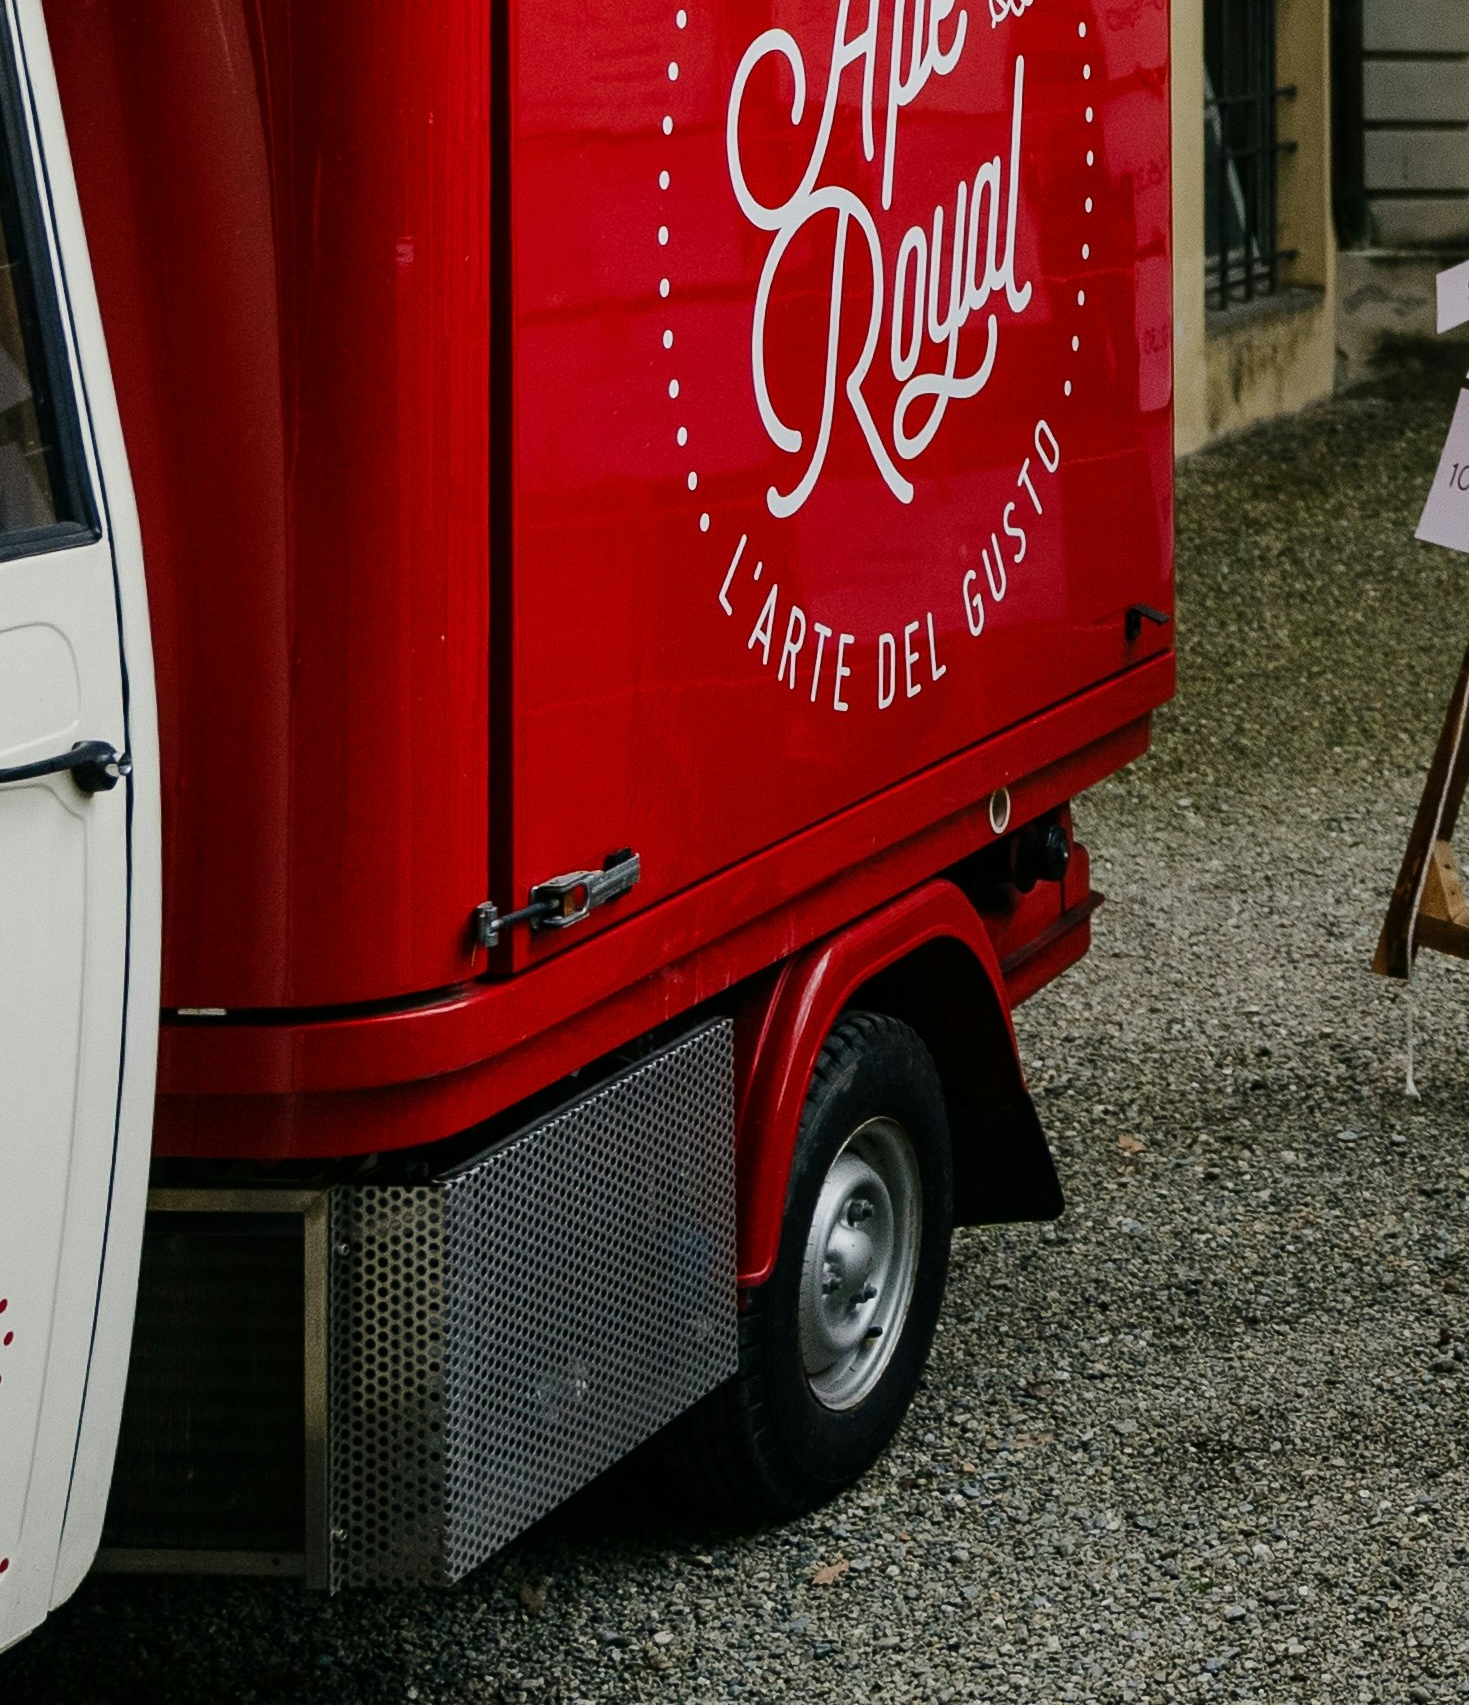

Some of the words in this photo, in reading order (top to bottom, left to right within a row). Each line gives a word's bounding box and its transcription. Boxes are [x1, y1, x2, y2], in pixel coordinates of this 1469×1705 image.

[752, 55, 1032, 519] Royal
[718, 534, 856, 713] L'ARTE
[878, 611, 948, 711] DEL
[962, 417, 1061, 633] GUSTO
